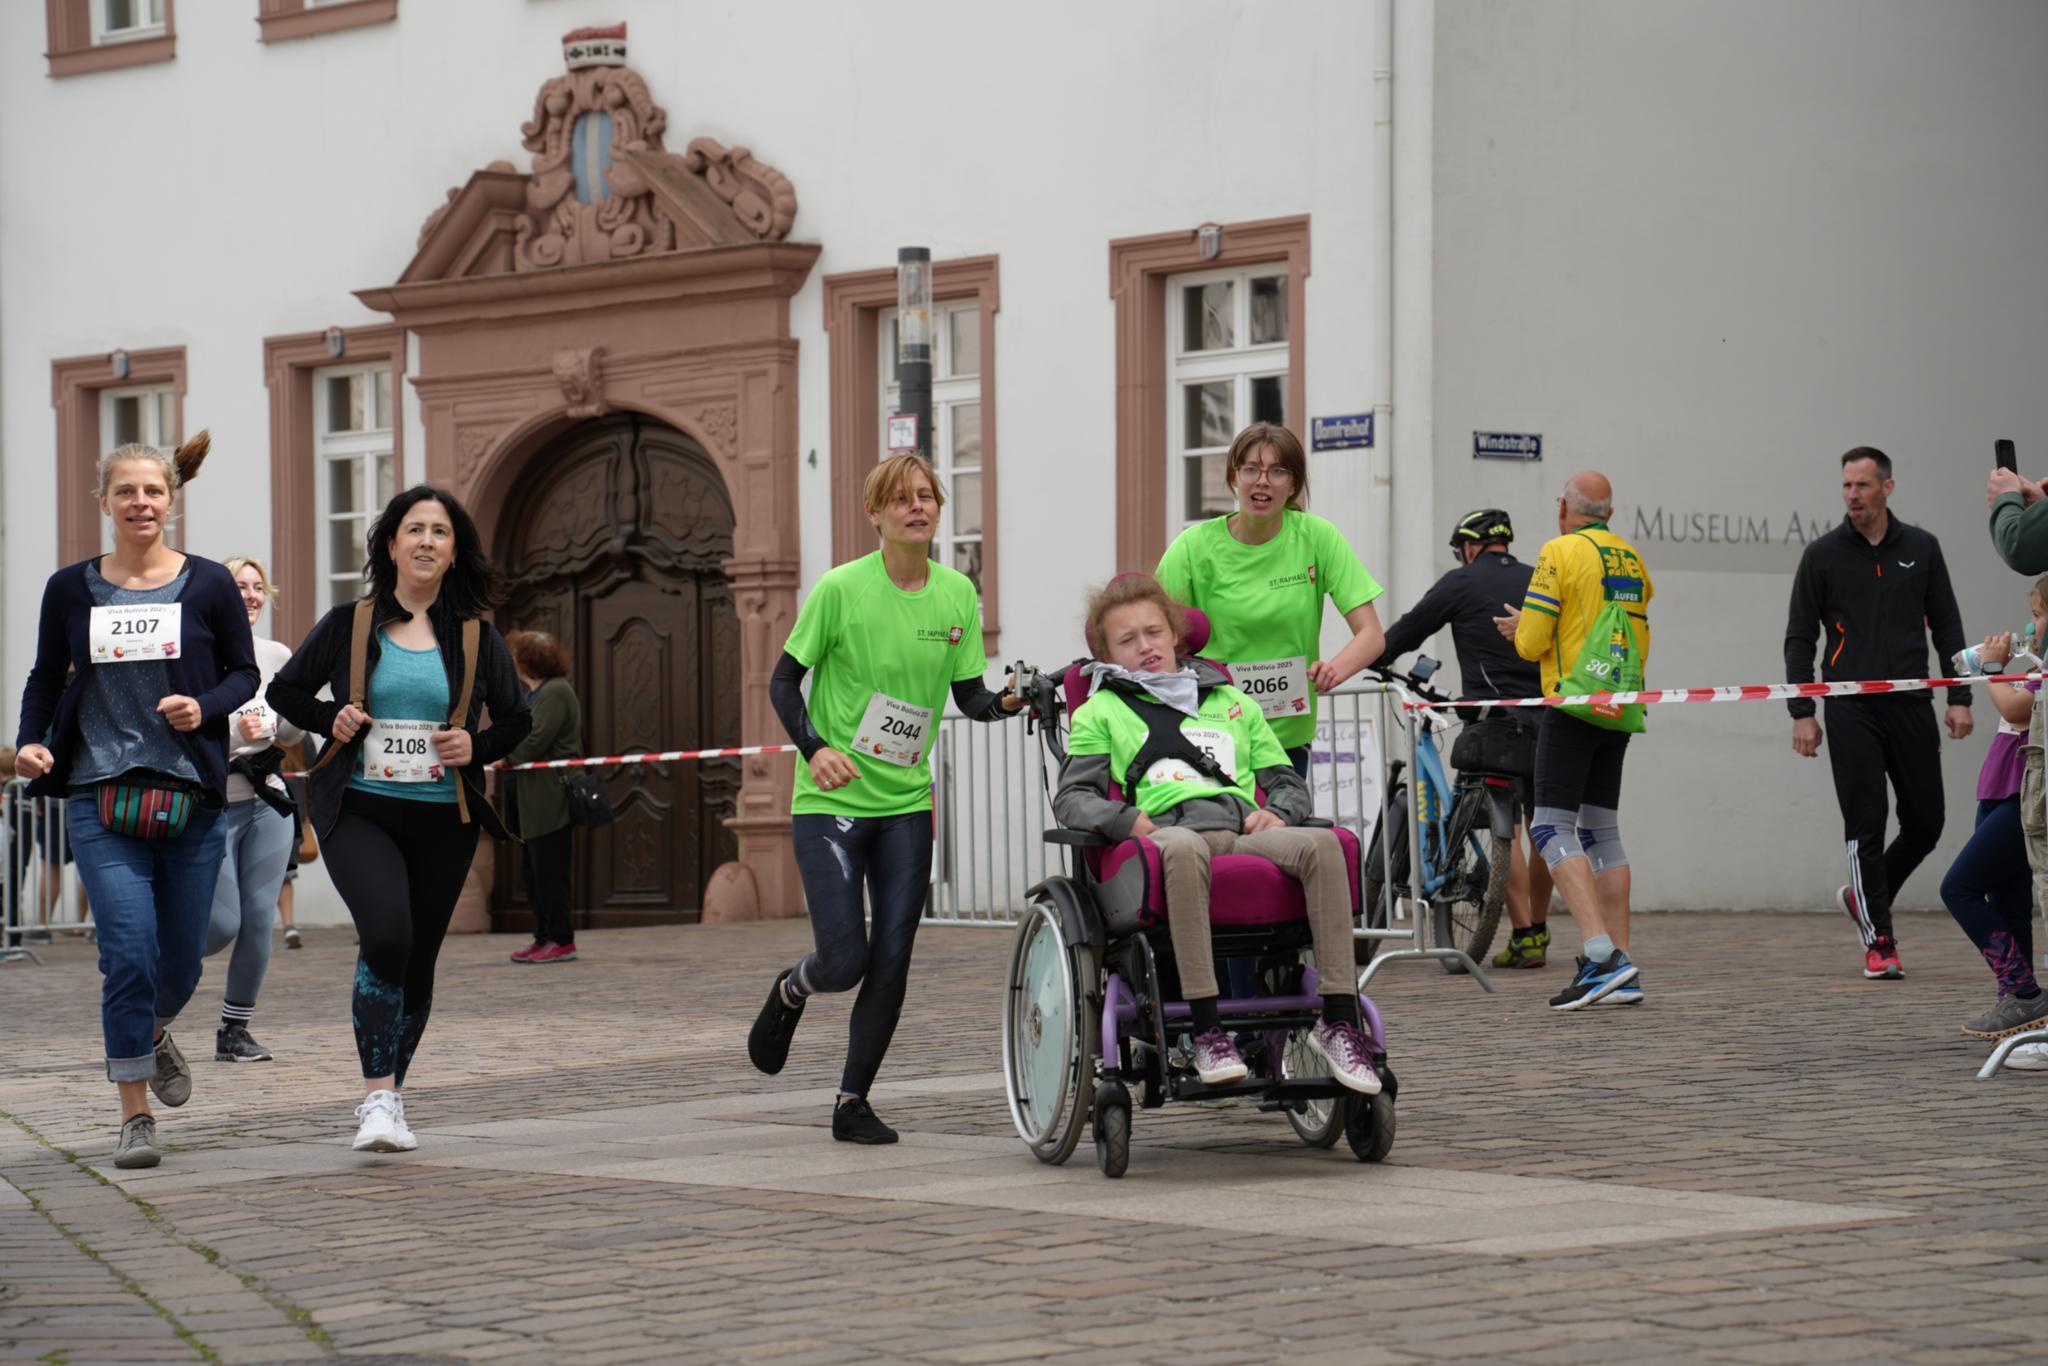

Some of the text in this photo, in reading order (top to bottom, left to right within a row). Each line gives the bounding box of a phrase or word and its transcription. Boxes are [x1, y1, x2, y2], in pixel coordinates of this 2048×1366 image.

[1633, 505, 1770, 545] MUSEUM
[111, 619, 160, 635] 2107
[1277, 661, 1293, 669] 2025
[1585, 658, 1610, 676] 30
[1241, 676, 1289, 695] 2066
[886, 699, 900, 710] Viva
[880, 716, 921, 741] 2044
[384, 738, 427, 755] 2108
